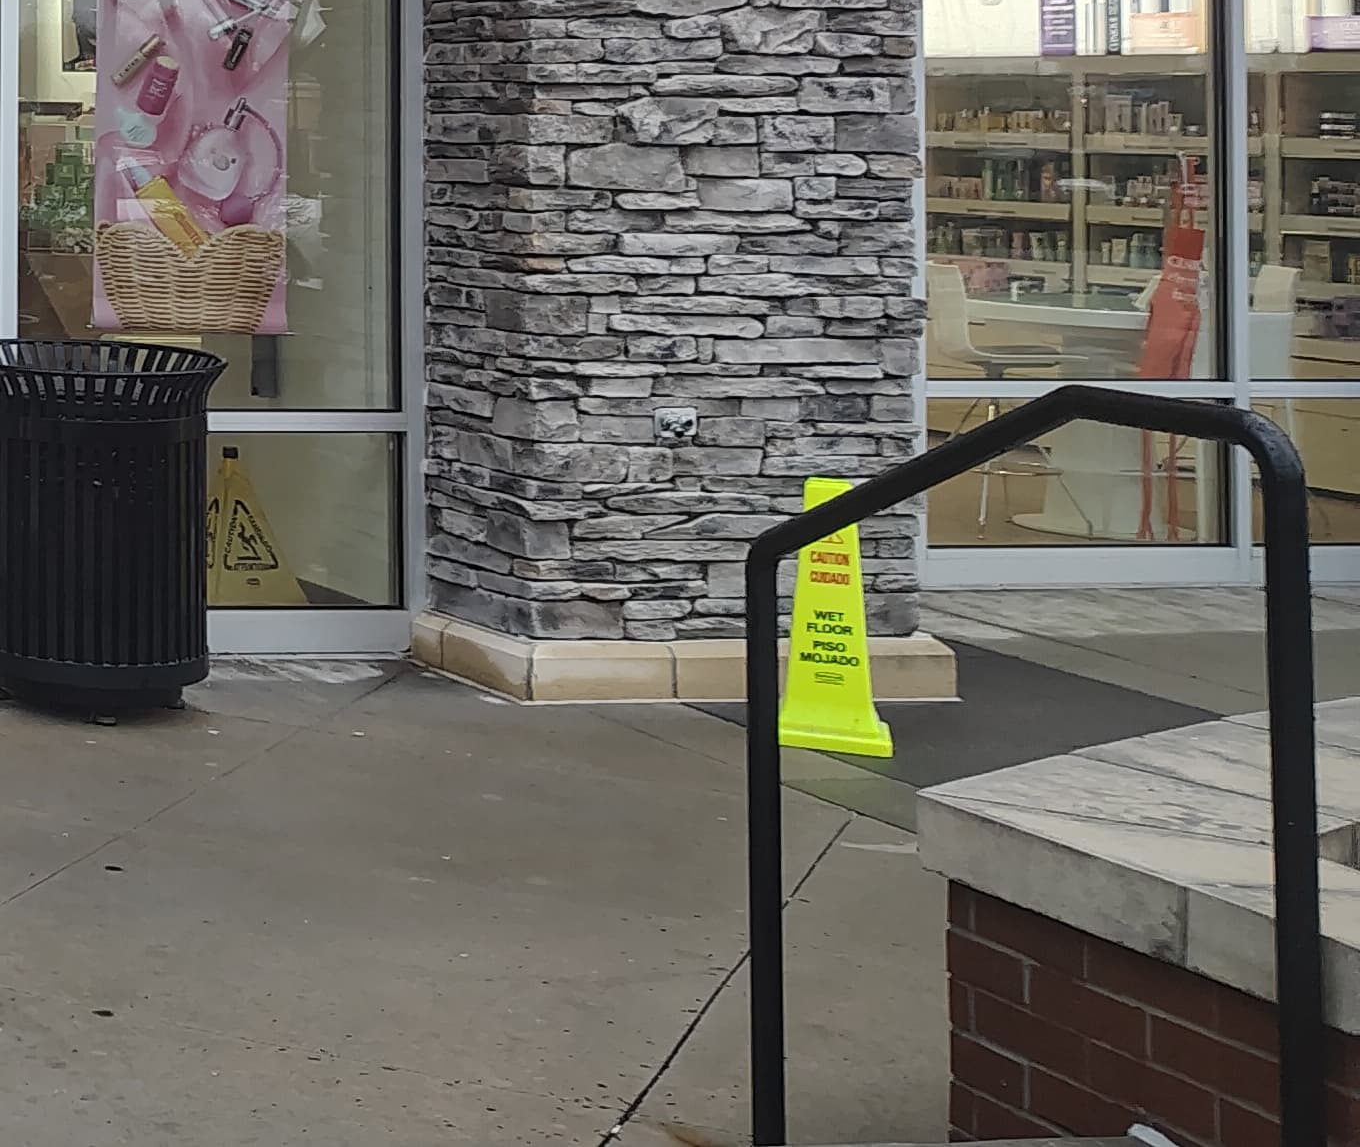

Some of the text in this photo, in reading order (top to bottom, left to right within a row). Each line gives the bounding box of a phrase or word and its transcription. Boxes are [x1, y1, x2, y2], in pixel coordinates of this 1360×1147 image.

[810, 550, 849, 566] CAUTION
[814, 609, 845, 622] WET
[806, 622, 854, 636] FLOOR
[812, 640, 848, 653] PISO
[799, 651, 860, 667] MOJADO
